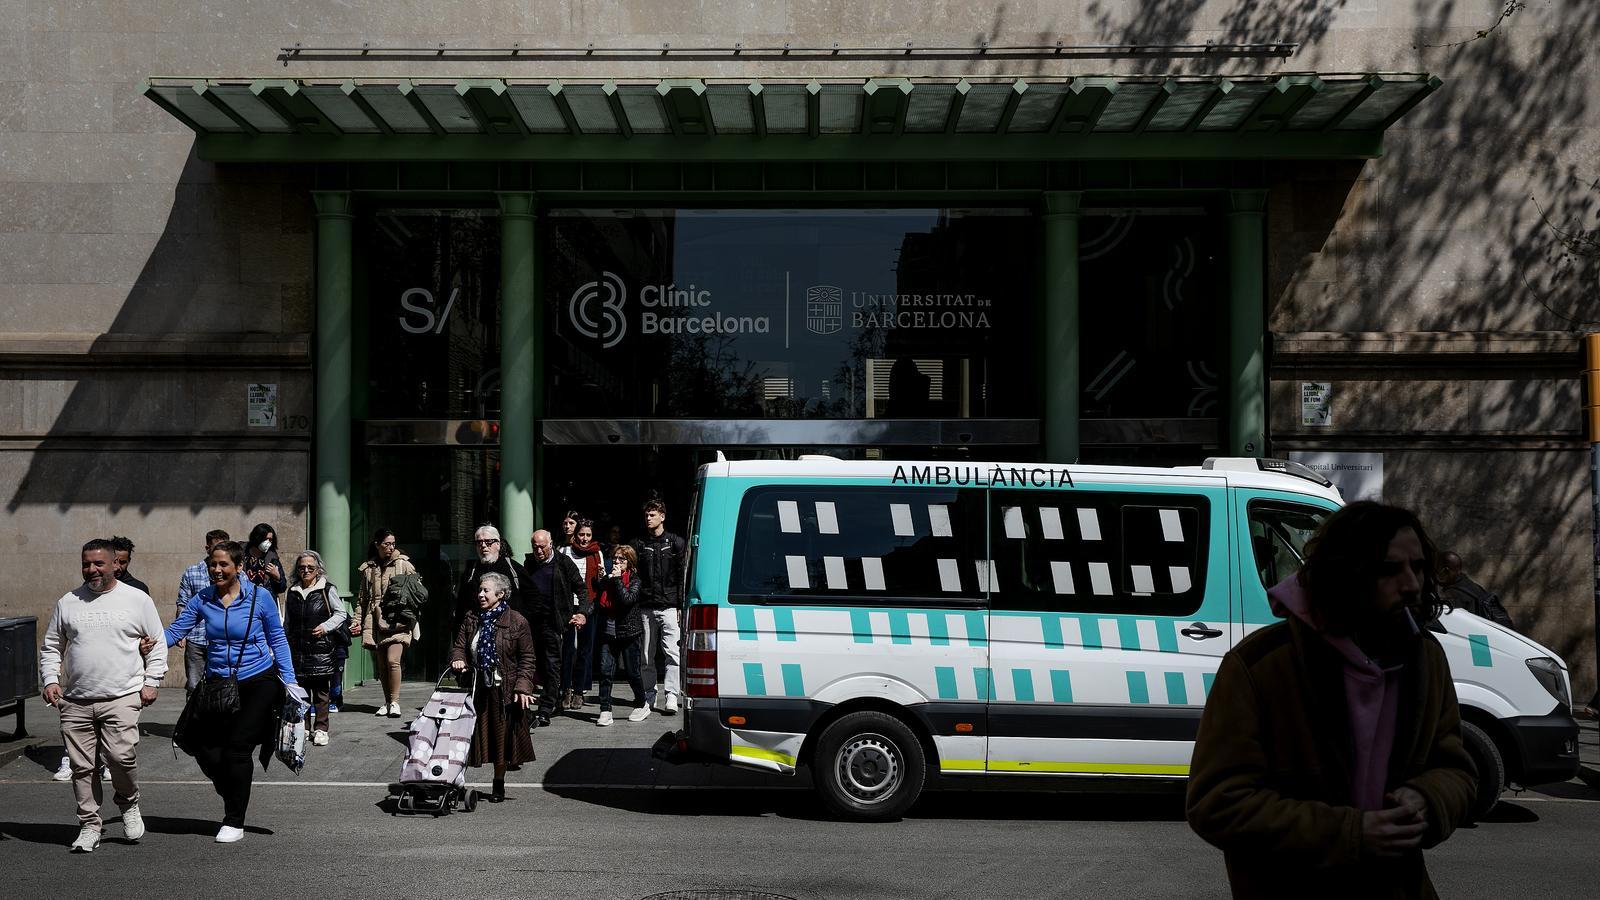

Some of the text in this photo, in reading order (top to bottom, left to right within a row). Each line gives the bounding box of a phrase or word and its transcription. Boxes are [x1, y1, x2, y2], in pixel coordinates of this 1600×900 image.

[639, 284, 713, 308] Clínic
[641, 311, 771, 335] Barcelona
[851, 311, 993, 329] BARCELONA
[282, 415, 309, 430] 170
[891, 464, 1075, 489] AMBULÀNCIA
[1302, 463, 1373, 472] ospital Universitari
